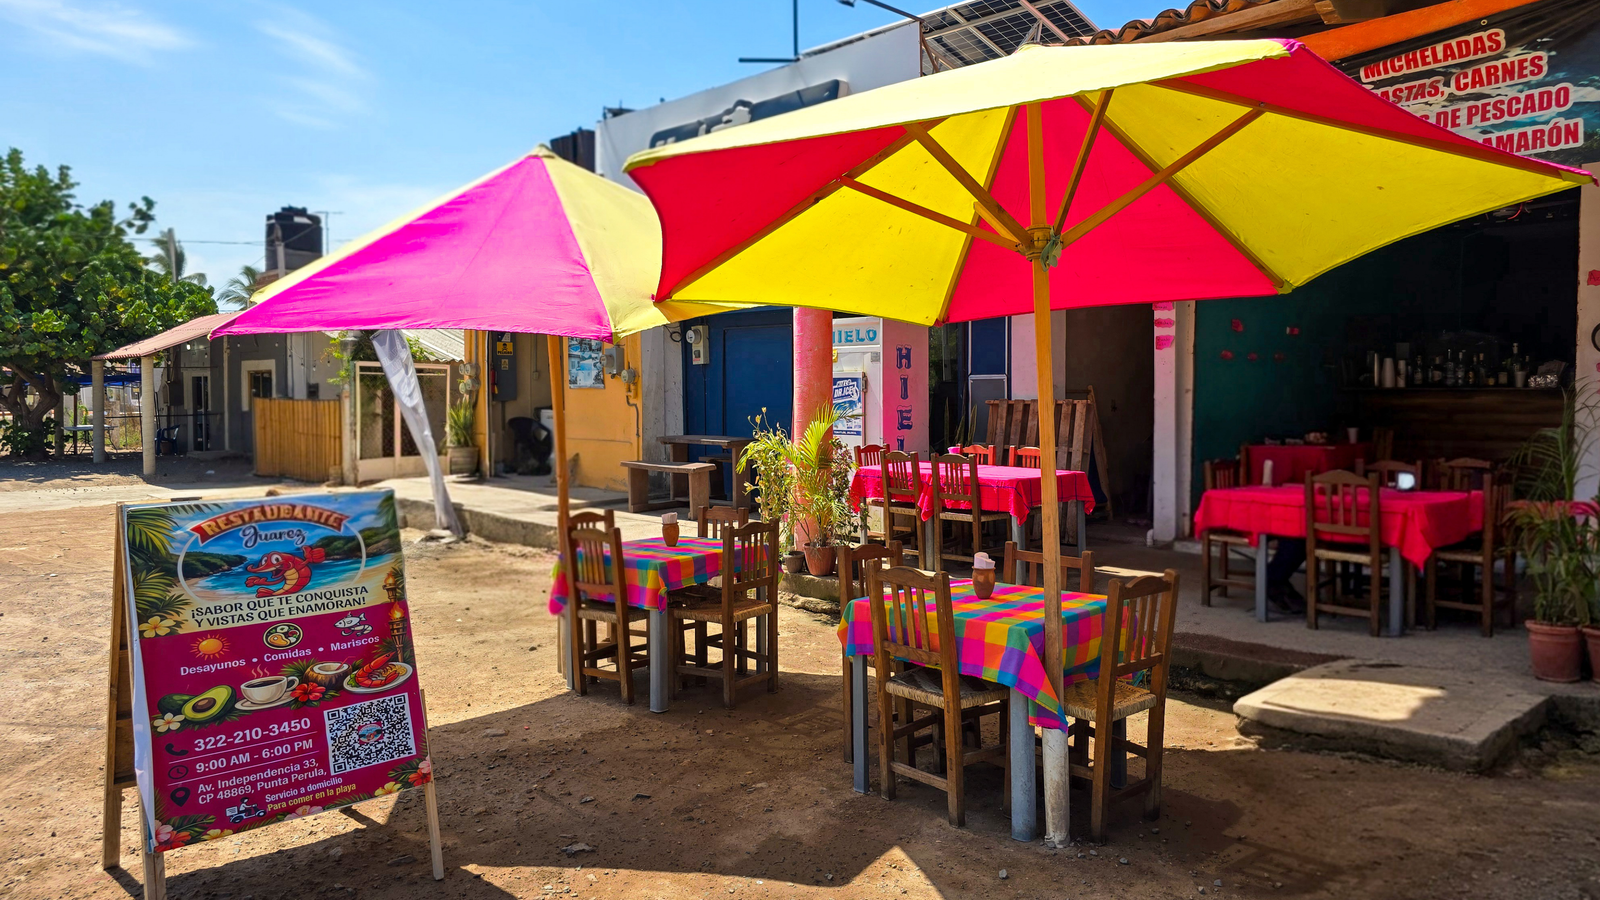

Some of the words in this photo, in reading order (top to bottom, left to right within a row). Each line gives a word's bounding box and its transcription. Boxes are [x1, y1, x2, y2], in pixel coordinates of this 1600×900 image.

[1363, 31, 1502, 80] MICHELADAS
[1376, 79, 1445, 105] ASTAS,
[1454, 55, 1544, 92] CARNES
[1436, 108, 1461, 129] DE
[1466, 86, 1570, 126] PESCADO
[241, 525, 307, 549] Juarez
[191, 602, 244, 619] ¡SABOR
[247, 597, 275, 611] QUE
[279, 596, 293, 605] TE
[295, 586, 368, 603] CONQUISTA
[195, 618, 204, 628] Y
[207, 613, 254, 626] VISTAS
[258, 606, 286, 621] QUE
[180, 658, 246, 676] Desayunos
[264, 647, 311, 662] Comidas
[330, 636, 379, 651] Mariscos
[194, 717, 311, 752] 322-210-3450
[196, 757, 227, 773] 9:00
[230, 752, 250, 766] AM
[262, 744, 291, 759] 6:00
[294, 739, 313, 752] PM
[197, 783, 215, 793] Av.
[218, 763, 300, 790] Independencia
[303, 758, 319, 770] 33,
[198, 794, 214, 805] CP
[217, 785, 255, 801] 48869,
[257, 776, 289, 791] Punta
[291, 767, 327, 783] Perula,
[265, 788, 298, 803] Servicio
[307, 777, 343, 792] domicilio
[267, 801, 287, 812] Para
[288, 795, 313, 806] comer
[315, 792, 325, 800] en
[327, 788, 334, 797] la
[336, 783, 357, 796] playa
